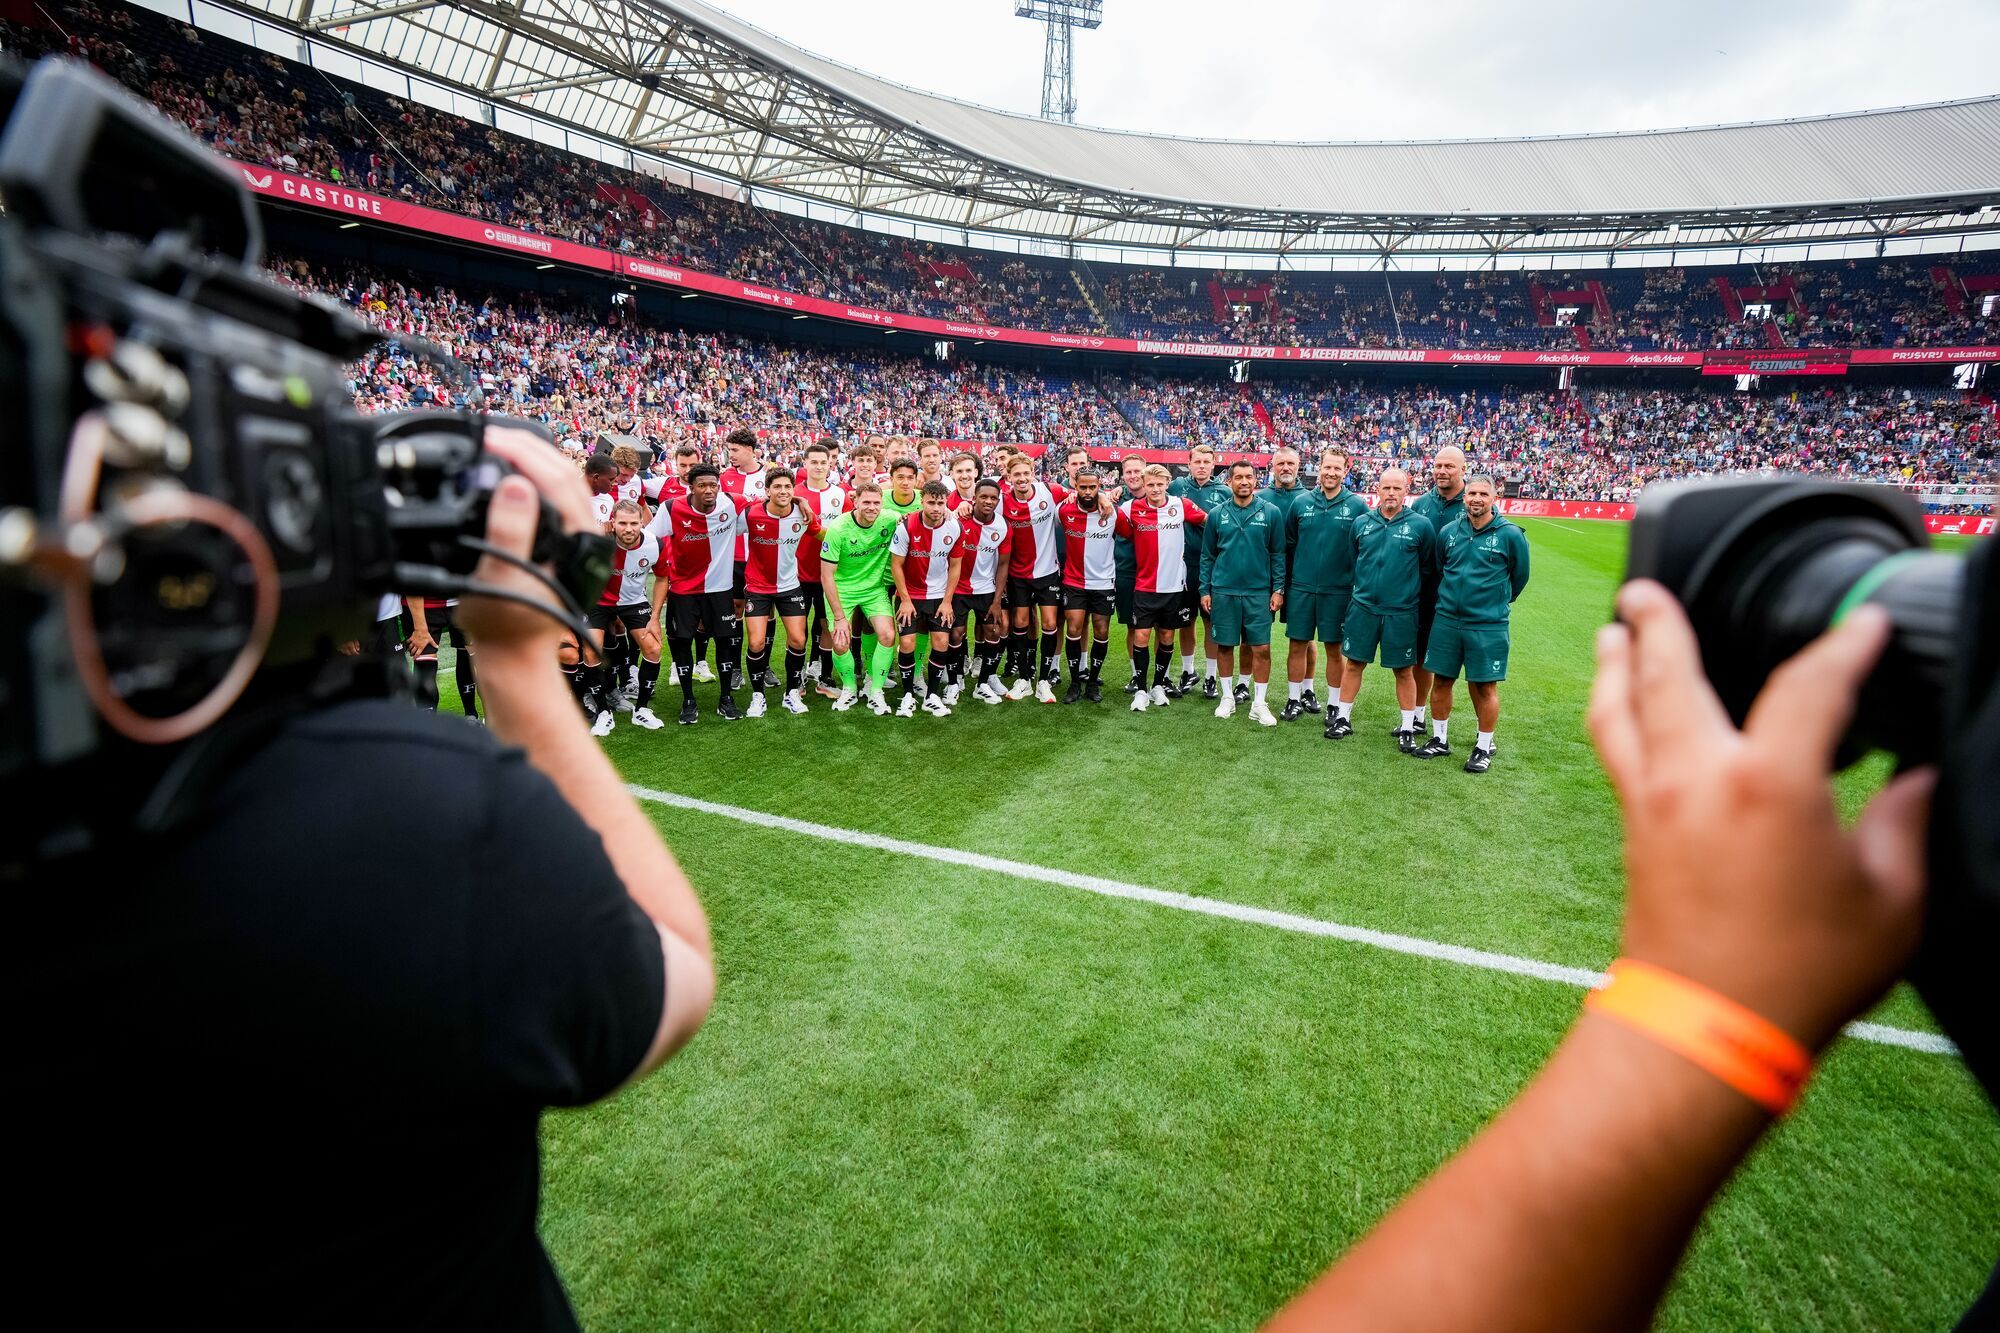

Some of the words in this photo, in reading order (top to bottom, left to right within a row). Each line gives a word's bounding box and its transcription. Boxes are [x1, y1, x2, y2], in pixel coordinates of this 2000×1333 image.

[283, 178, 382, 215] CASTORE
[495, 229, 553, 253] EUROJACKPOT
[638, 262, 682, 282] EUROJACKPOT
[743, 287, 772, 301] Heineken
[847, 308, 873, 320] Heineken
[946, 323, 977, 335] Dusseldorp
[1050, 335, 1081, 345] Dusseldorp
[1137, 341, 1185, 354] WINNAAR
[1185, 343, 1243, 356] EUROPACUP
[1250, 347, 1275, 358] 1970
[1299, 348, 1311, 359] 14
[1312, 349, 1339, 360] KEER
[1338, 350, 1426, 361] BEKERWINNAAR
[1947, 350, 1997, 359] vakanties
[721, 661, 733, 672] F
[1068, 658, 1079, 667] F
[1092, 658, 1103, 667] F
[677, 665, 690, 676] F
[752, 671, 764, 681] F
[901, 670, 912, 679] F
[589, 685, 602, 695] F
